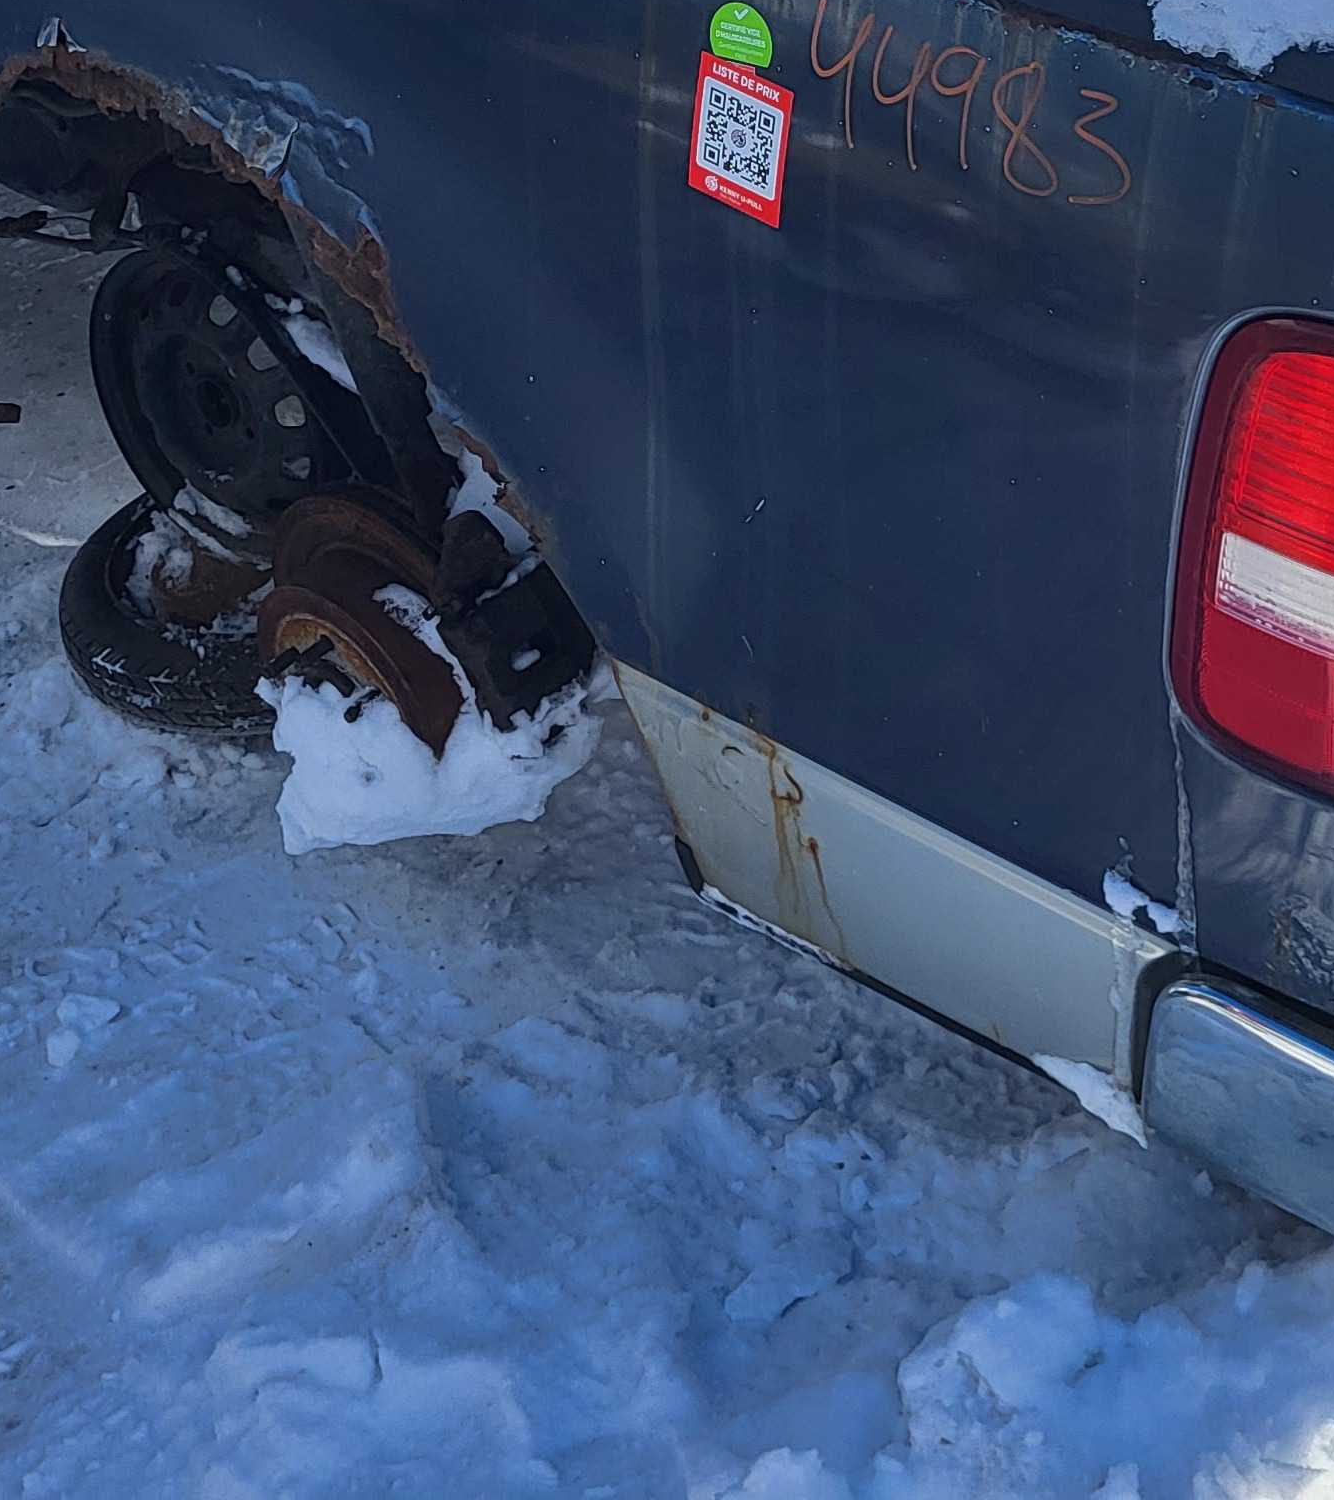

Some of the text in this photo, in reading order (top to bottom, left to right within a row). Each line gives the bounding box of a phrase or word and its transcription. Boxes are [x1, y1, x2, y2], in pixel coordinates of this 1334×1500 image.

[712, 61, 781, 103] LISTE DE PRIX
